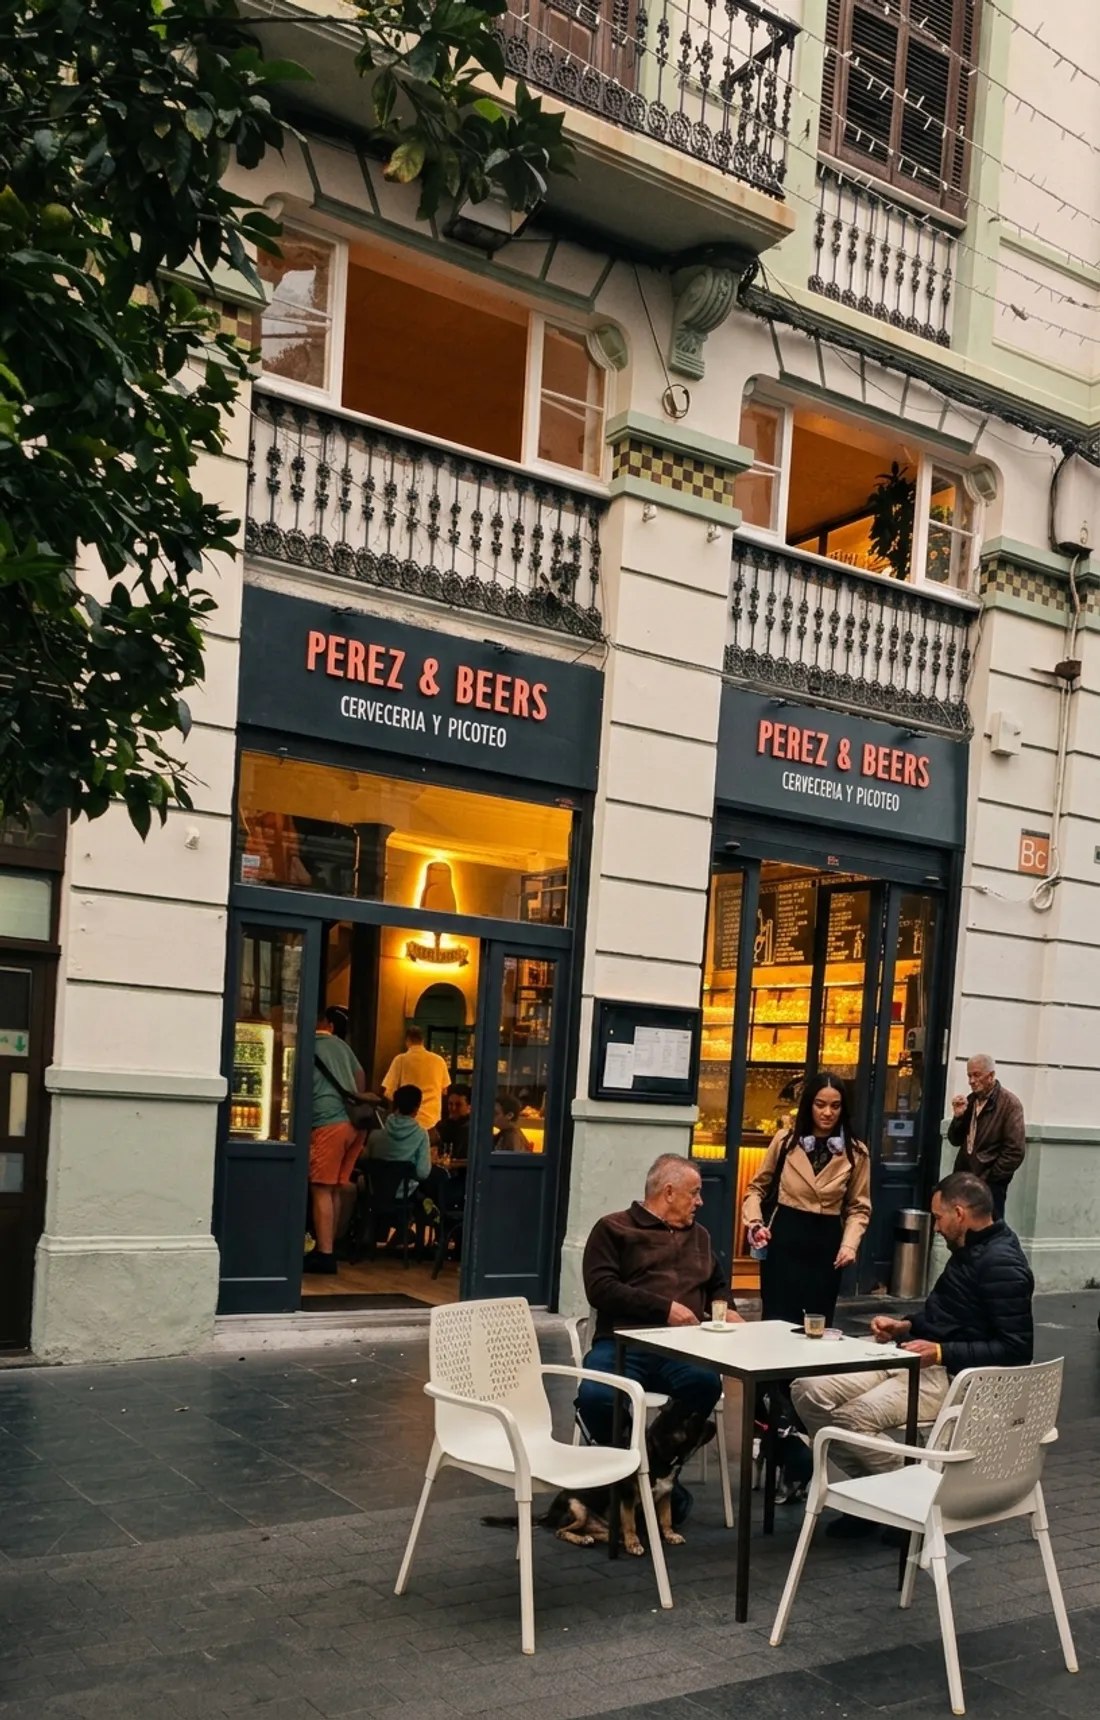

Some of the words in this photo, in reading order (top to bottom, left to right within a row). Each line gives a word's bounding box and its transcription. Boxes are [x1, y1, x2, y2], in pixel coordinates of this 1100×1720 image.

[306, 630, 406, 690] PEREZ
[418, 658, 440, 696] &
[456, 665, 548, 721] BEERS
[340, 695, 426, 733] CERVECERIA
[432, 715, 442, 735] Y
[448, 717, 507, 748] PICOTEO
[757, 719, 829, 767] PEREZ
[836, 738, 851, 770] &
[862, 744, 930, 788] BEERS
[845, 784, 854, 803] Y
[856, 786, 900, 812] PICOTEO
[1020, 839, 1047, 870] Bc
